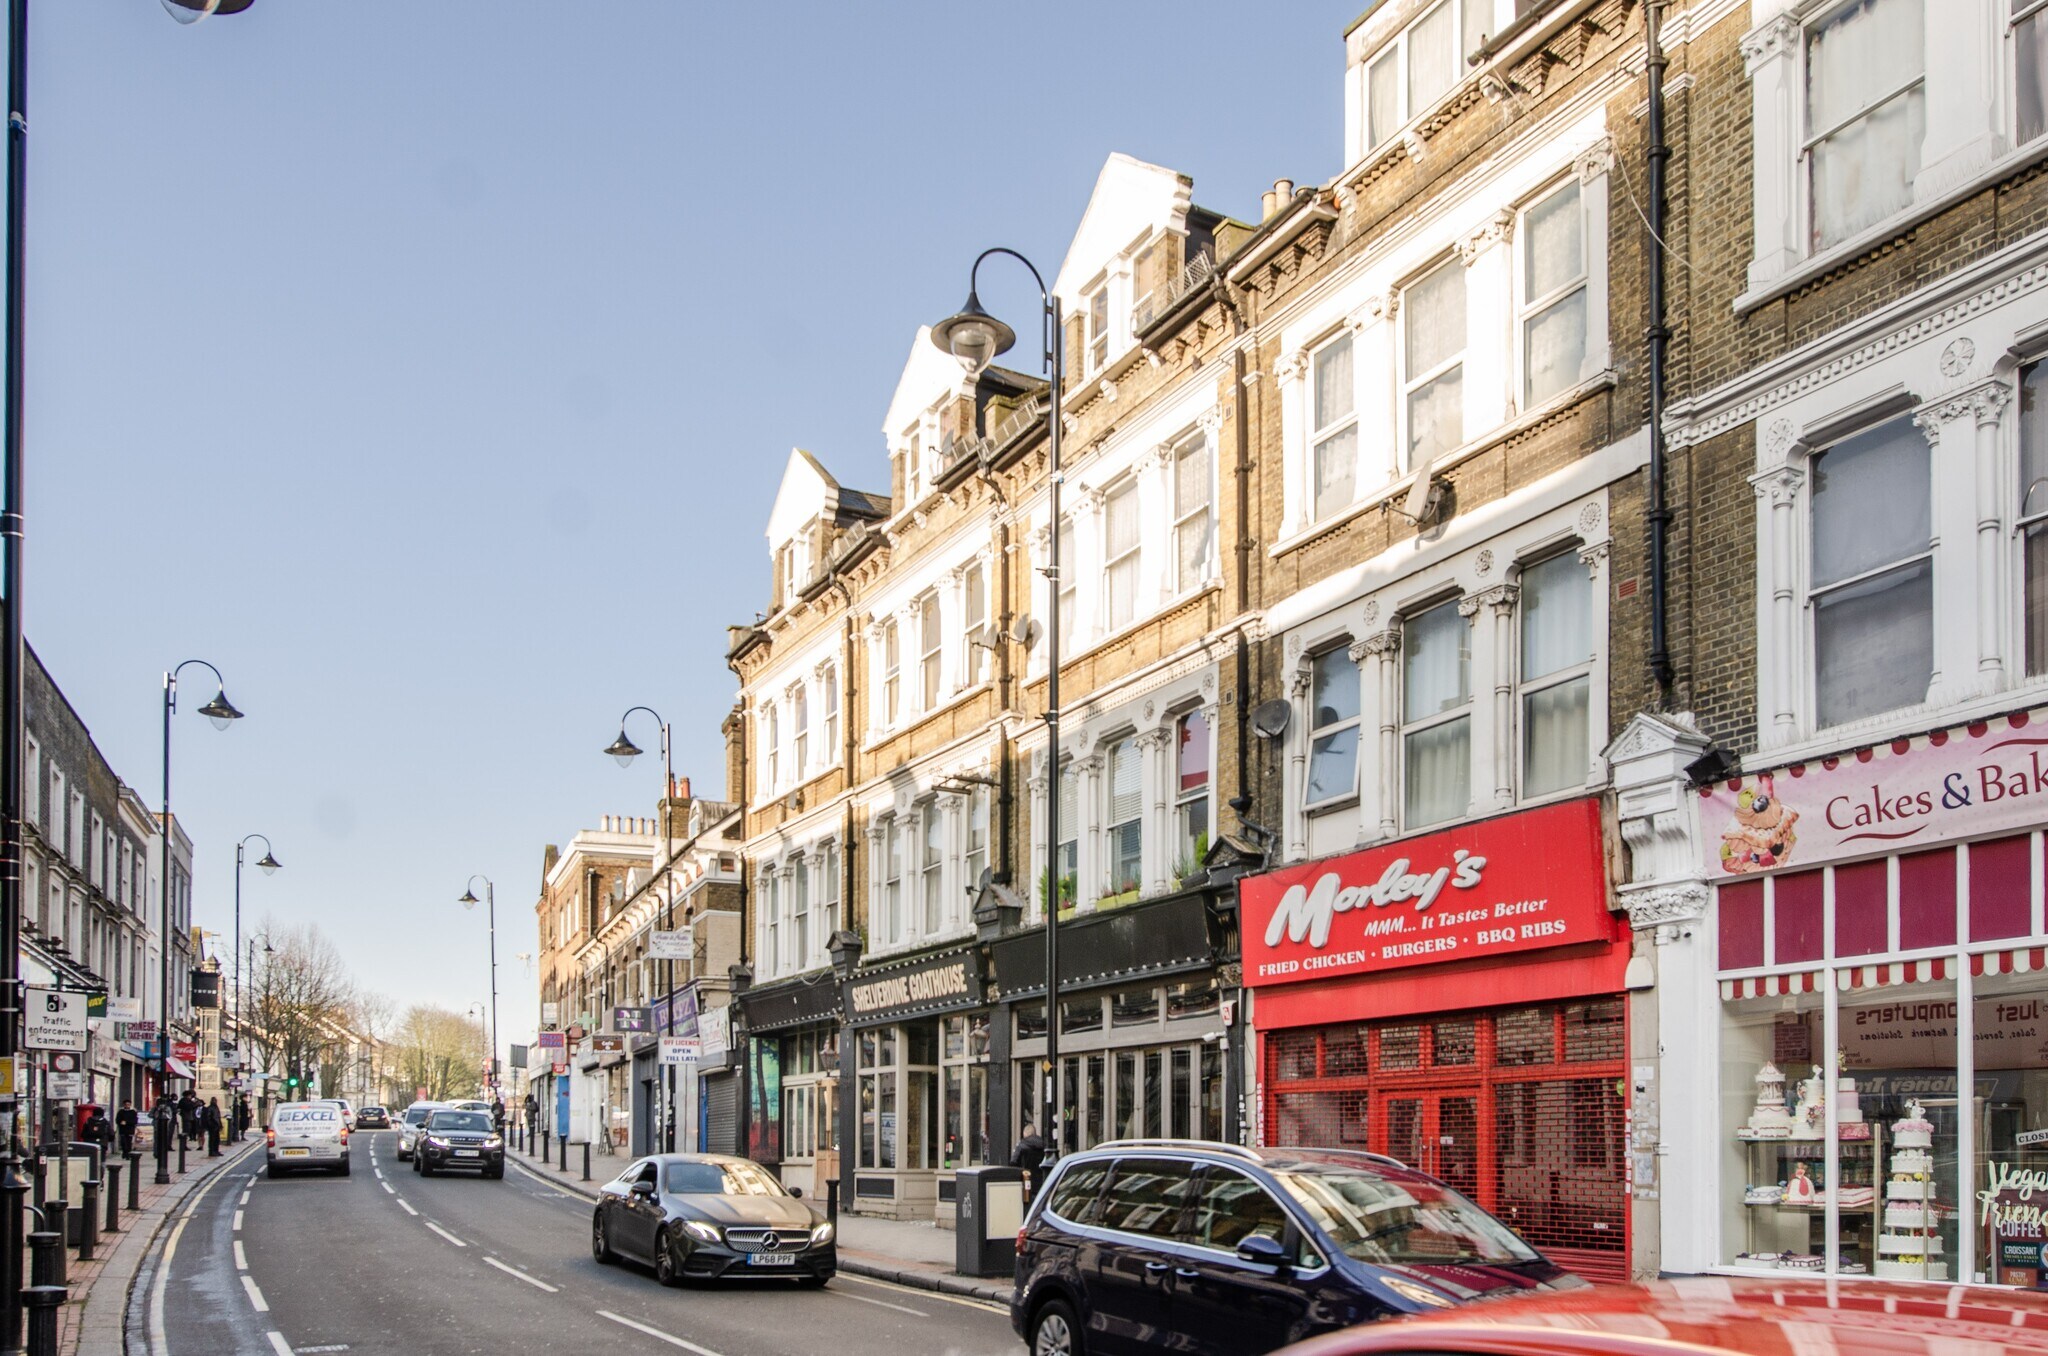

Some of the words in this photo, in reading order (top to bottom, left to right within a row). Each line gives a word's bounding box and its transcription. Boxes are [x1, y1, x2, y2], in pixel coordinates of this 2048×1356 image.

[1825, 784, 1933, 830] Cakes
[1941, 772, 1973, 810] &
[1264, 849, 1487, 948] Morley's
[1364, 916, 1416, 938] MMM...
[1421, 915, 1434, 930] It
[1439, 907, 1488, 927] Tastes
[1494, 899, 1548, 918] Better
[1259, 961, 1299, 976] FRIED
[1303, 951, 1366, 970] CHICKEN
[1382, 937, 1457, 959] BURGERS
[1477, 927, 1516, 945] BBQ
[1521, 919, 1567, 938] RIBS
[852, 976, 910, 1012] SHELVERDINE
[909, 963, 968, 1001] GOATHOUSE
[43, 1016, 71, 1026] Traffic
[127, 1021, 156, 1031] CHINESE
[28, 1026, 84, 1037] enforcement
[37, 1037, 76, 1046] cameras
[292, 1111, 336, 1121] EXCEL
[2004, 1245, 2037, 1255] CROISSANT
